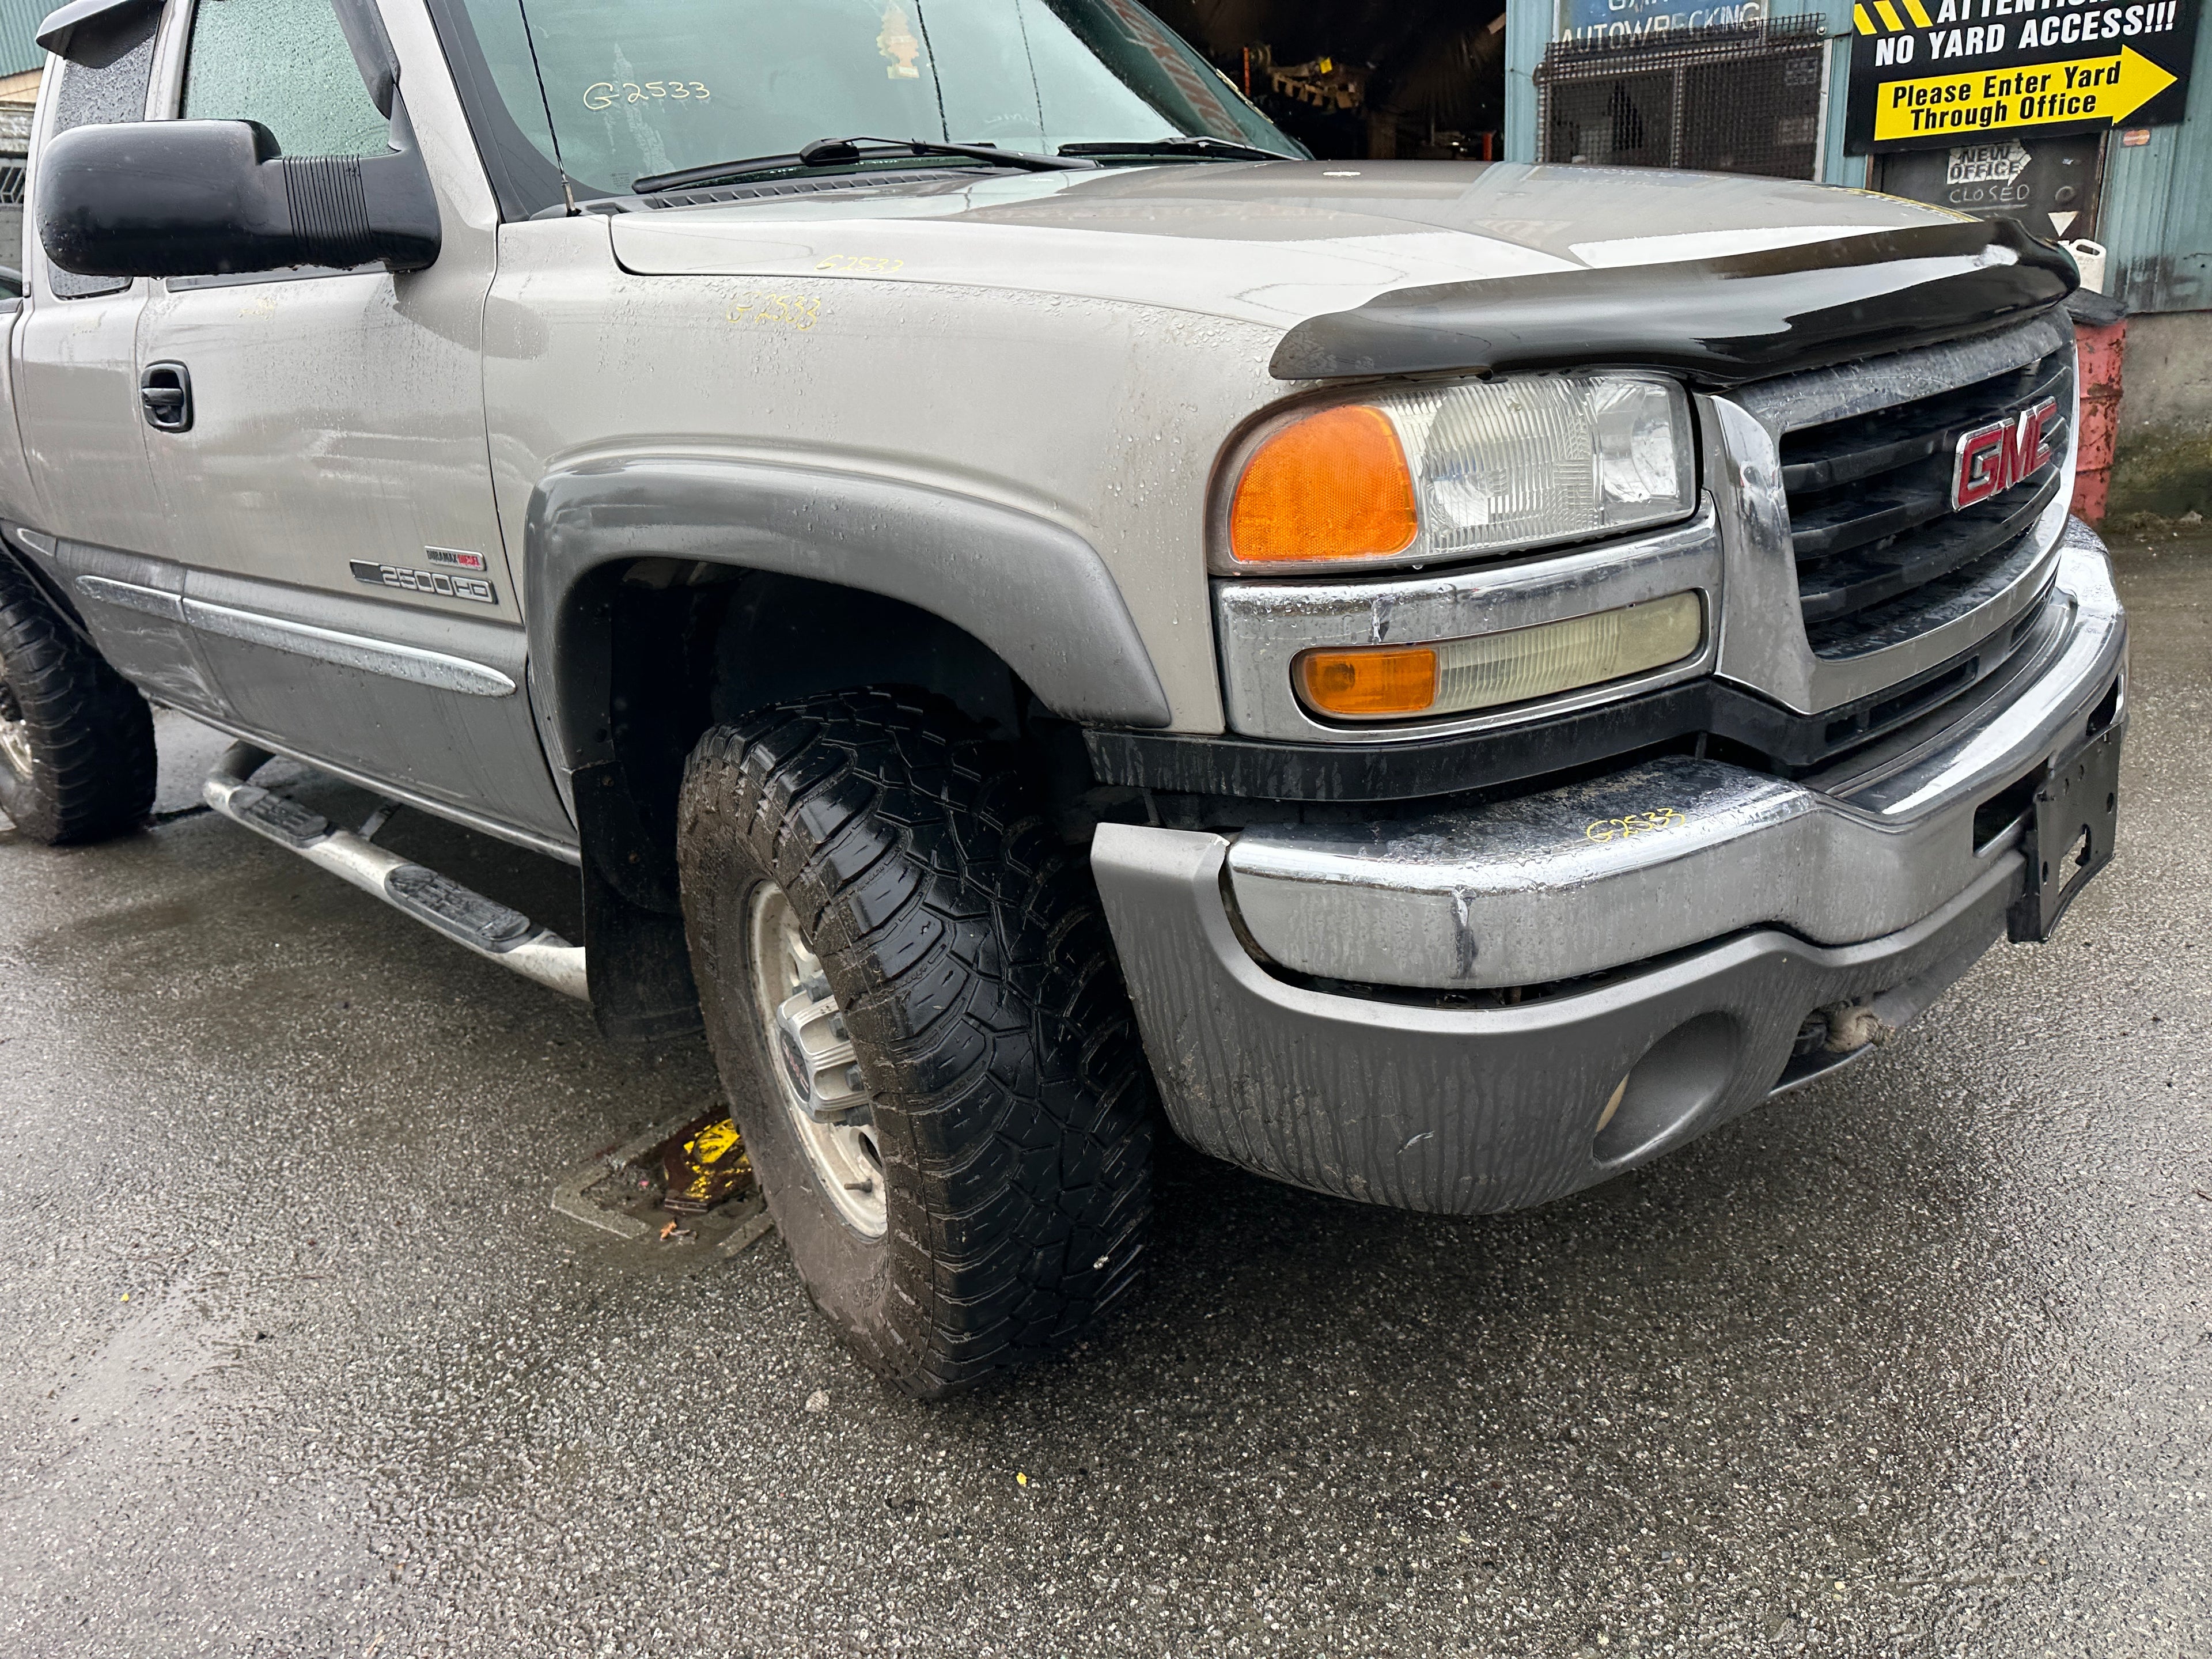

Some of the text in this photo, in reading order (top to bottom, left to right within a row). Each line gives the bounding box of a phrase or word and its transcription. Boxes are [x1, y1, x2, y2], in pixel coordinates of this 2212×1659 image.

[1875, 1, 2176, 67] NO YARD ACCESS!!!
[583, 82, 710, 110] G2533
[1893, 60, 2121, 108] Please Enter Yard
[1910, 93, 2096, 131] Through Office
[1950, 162, 2021, 180] OFFICE
[1961, 147, 2010, 163] NEW
[1949, 184, 2030, 203] CLOSED
[1951, 396, 2057, 512] GMC
[380, 566, 493, 604] 2500HD
[1586, 808, 1685, 843] G2533
